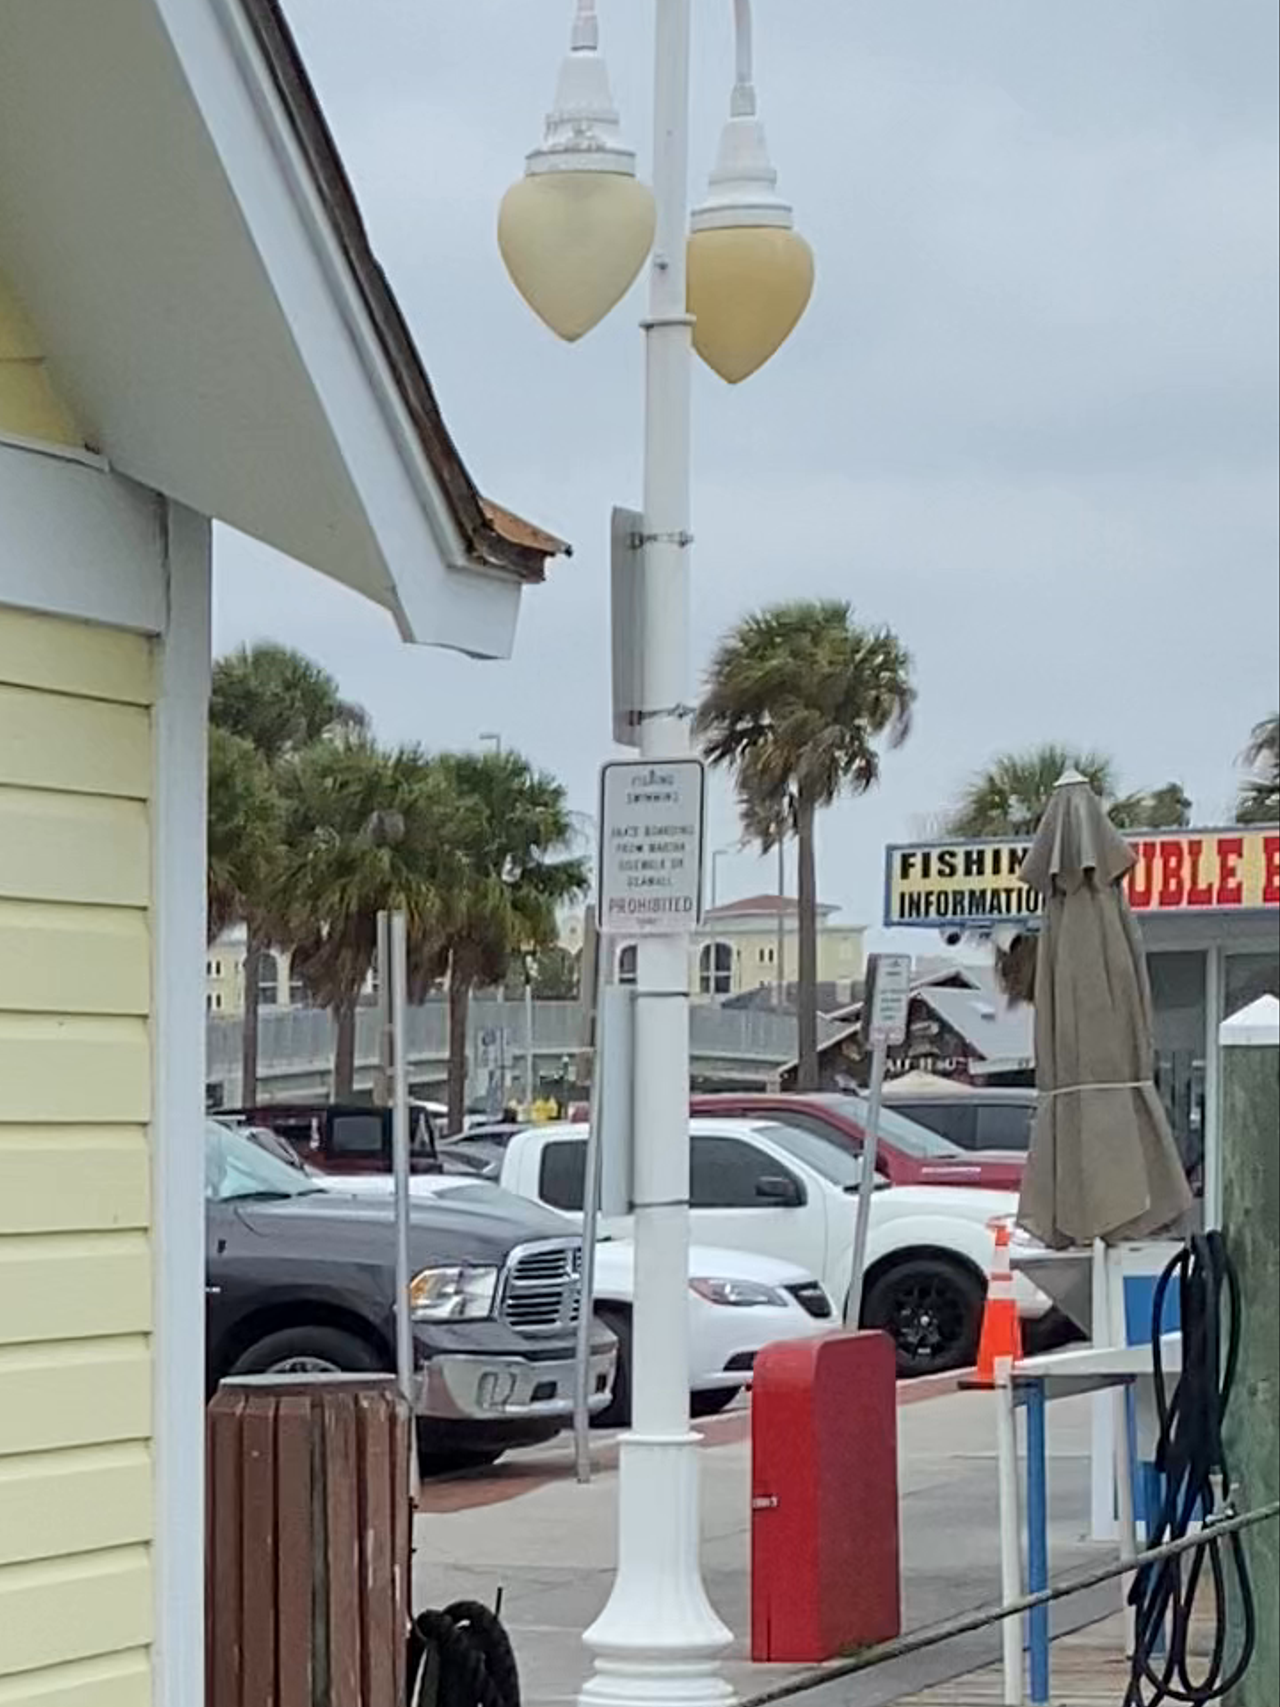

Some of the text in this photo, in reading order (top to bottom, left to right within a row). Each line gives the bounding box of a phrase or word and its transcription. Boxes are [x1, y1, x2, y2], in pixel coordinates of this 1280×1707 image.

[899, 847, 1028, 881] FISHIN
[1128, 837, 1244, 908] UBLE
[608, 896, 694, 914] PROHIBITED
[898, 887, 1046, 920] INFORMATIO
